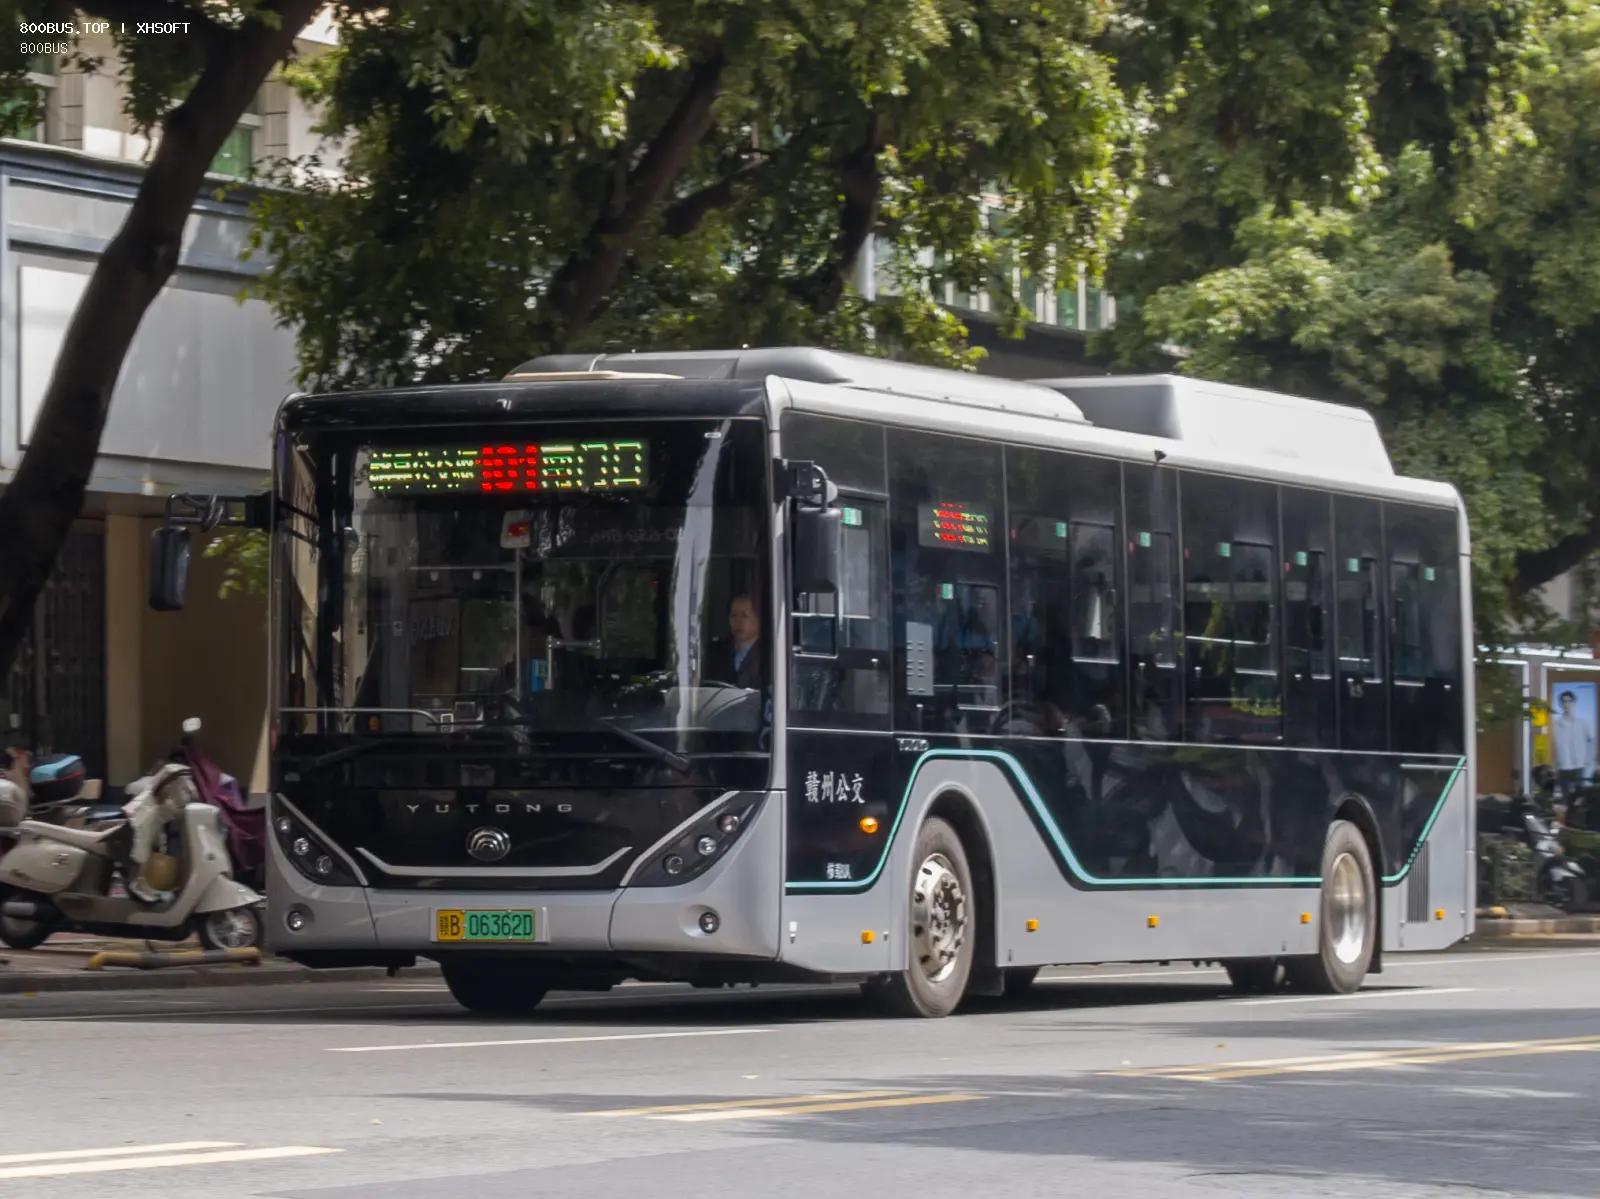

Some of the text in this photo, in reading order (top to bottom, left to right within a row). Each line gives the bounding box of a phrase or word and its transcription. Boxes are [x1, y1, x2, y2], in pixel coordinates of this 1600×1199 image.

[804, 771, 866, 804] 赣州公交
[407, 804, 572, 813] YUTONG
